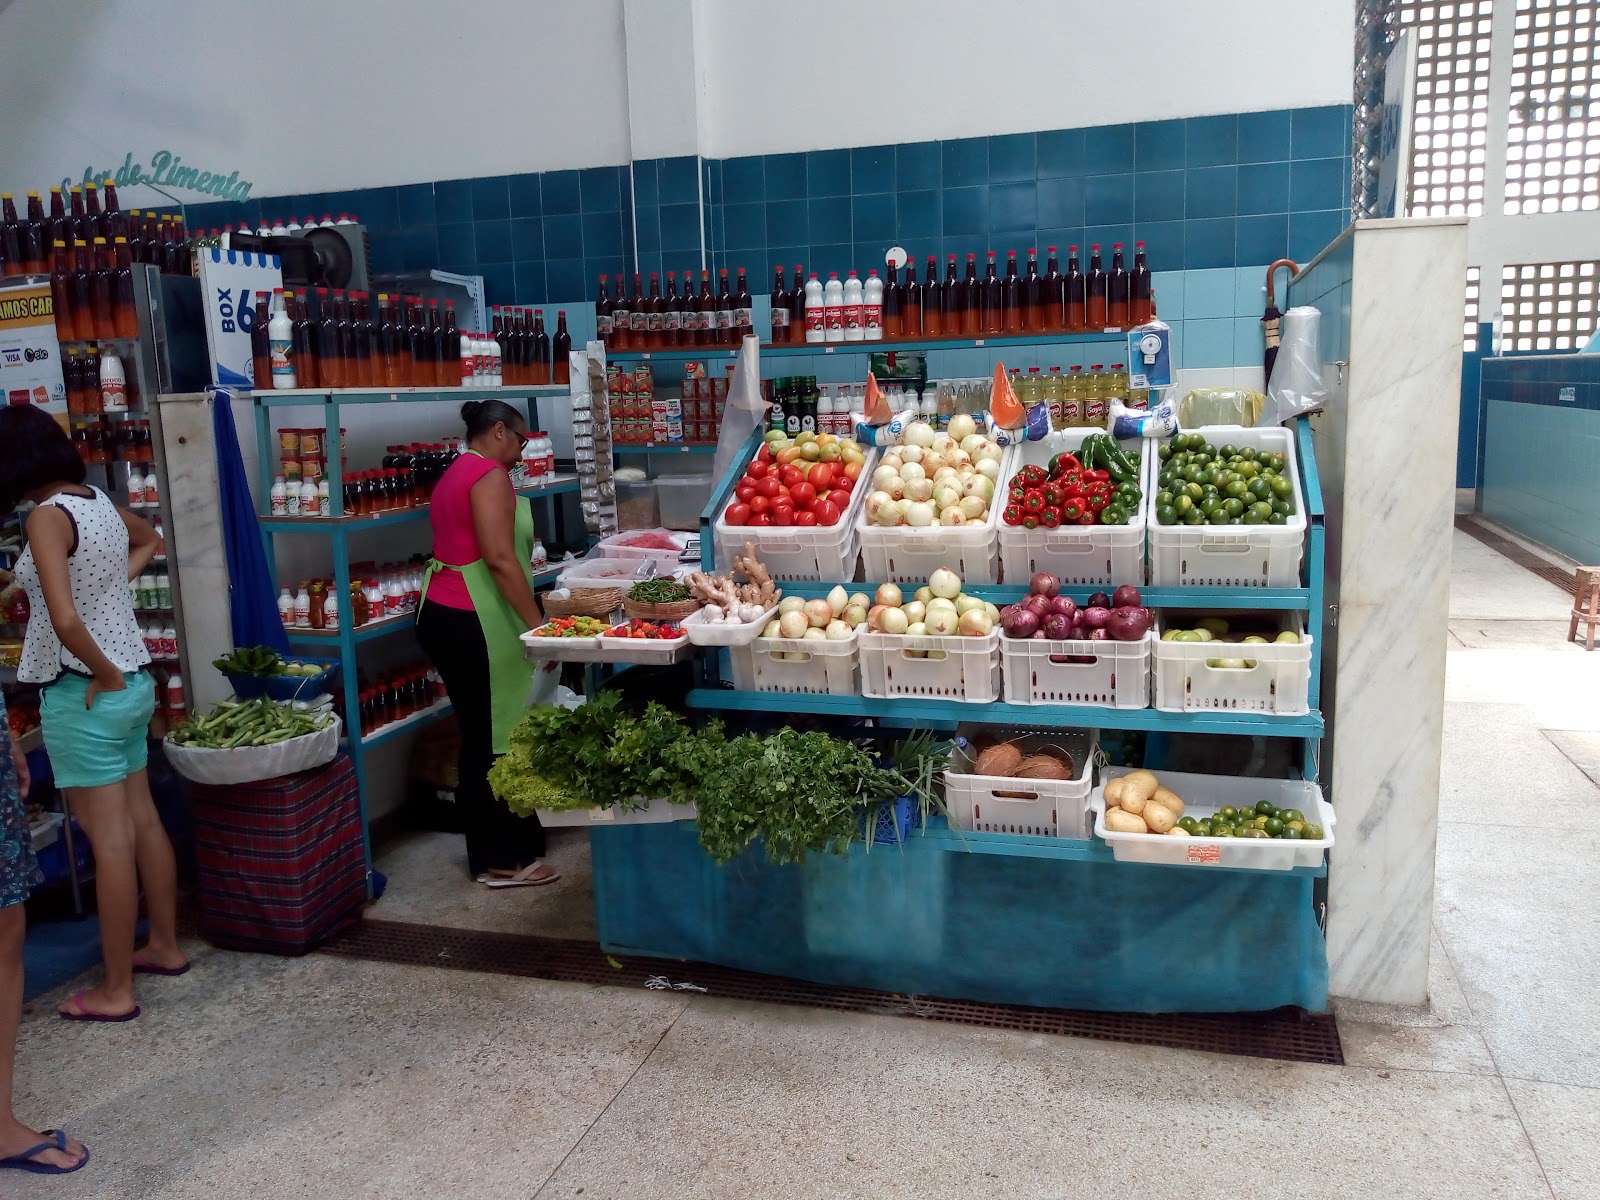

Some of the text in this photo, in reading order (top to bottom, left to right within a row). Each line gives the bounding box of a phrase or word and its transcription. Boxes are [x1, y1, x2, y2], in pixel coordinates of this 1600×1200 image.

[61, 150, 253, 209] Sbor de Pimenta
[217, 287, 236, 333] BOX
[5, 354, 21, 362] VISA
[1088, 404, 1103, 415] Soya
